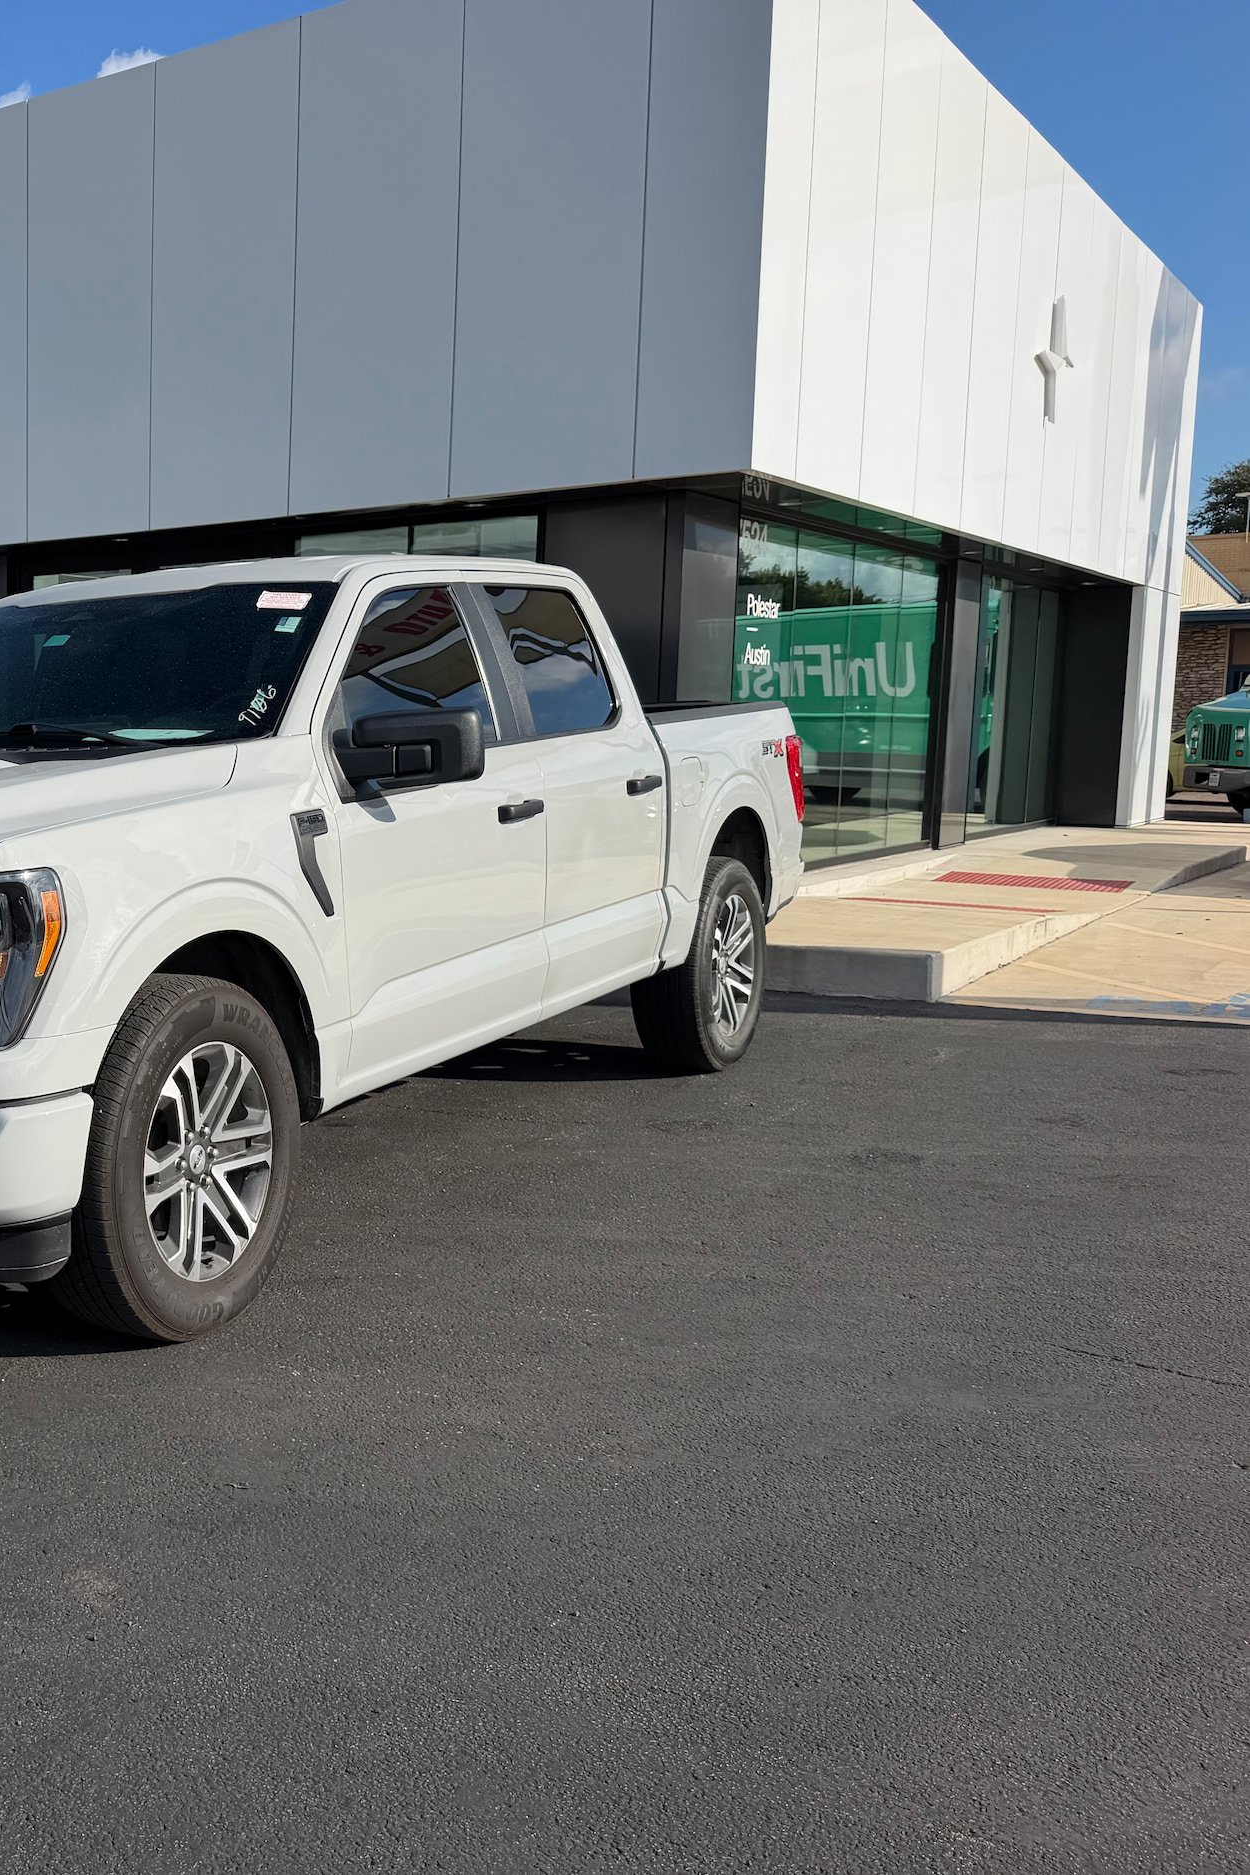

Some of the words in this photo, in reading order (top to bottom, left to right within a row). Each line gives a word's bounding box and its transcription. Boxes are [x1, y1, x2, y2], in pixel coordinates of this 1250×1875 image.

[747, 593, 781, 618] Polestar
[744, 642, 771, 666] Austin
[761, 738, 784, 758] STX
[222, 1002, 296, 1105] WRANGLER
